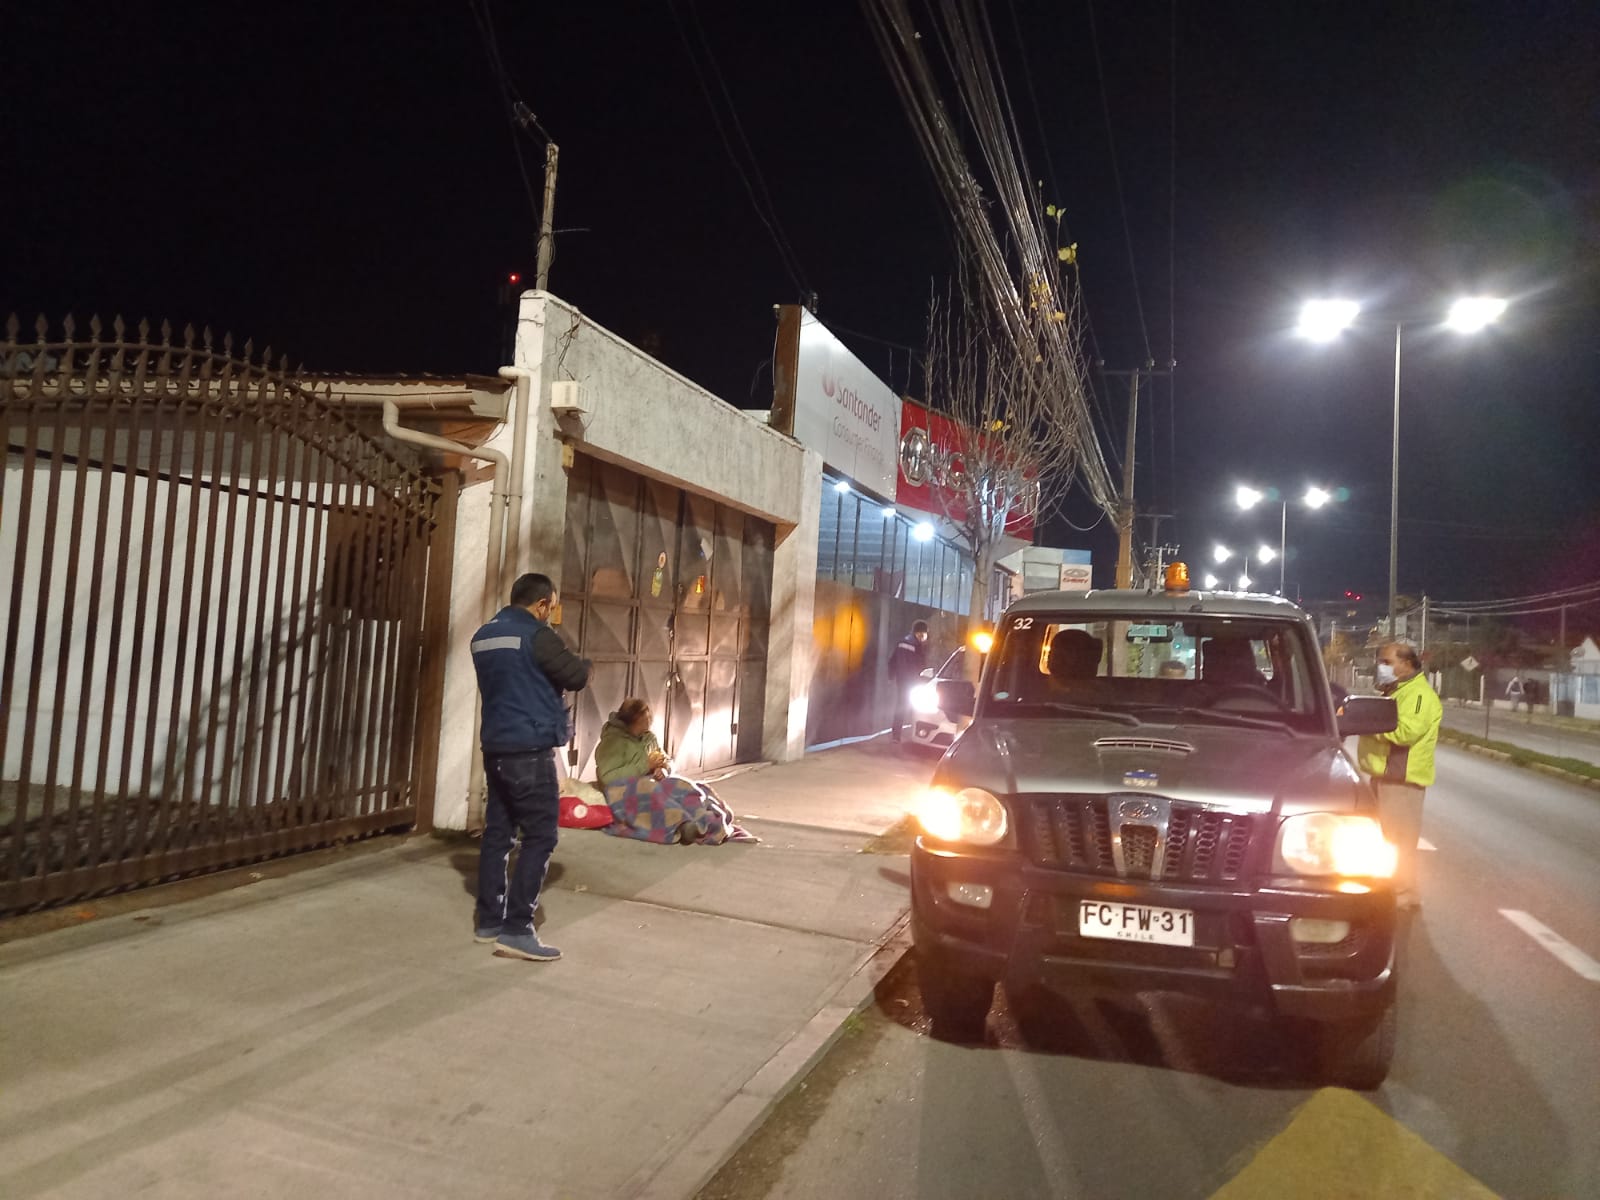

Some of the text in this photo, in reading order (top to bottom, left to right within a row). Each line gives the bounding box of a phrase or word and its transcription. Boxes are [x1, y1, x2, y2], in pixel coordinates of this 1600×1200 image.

[836, 377, 881, 432] Santander
[1013, 617, 1034, 630] 32
[1117, 931, 1155, 942] CHILE
